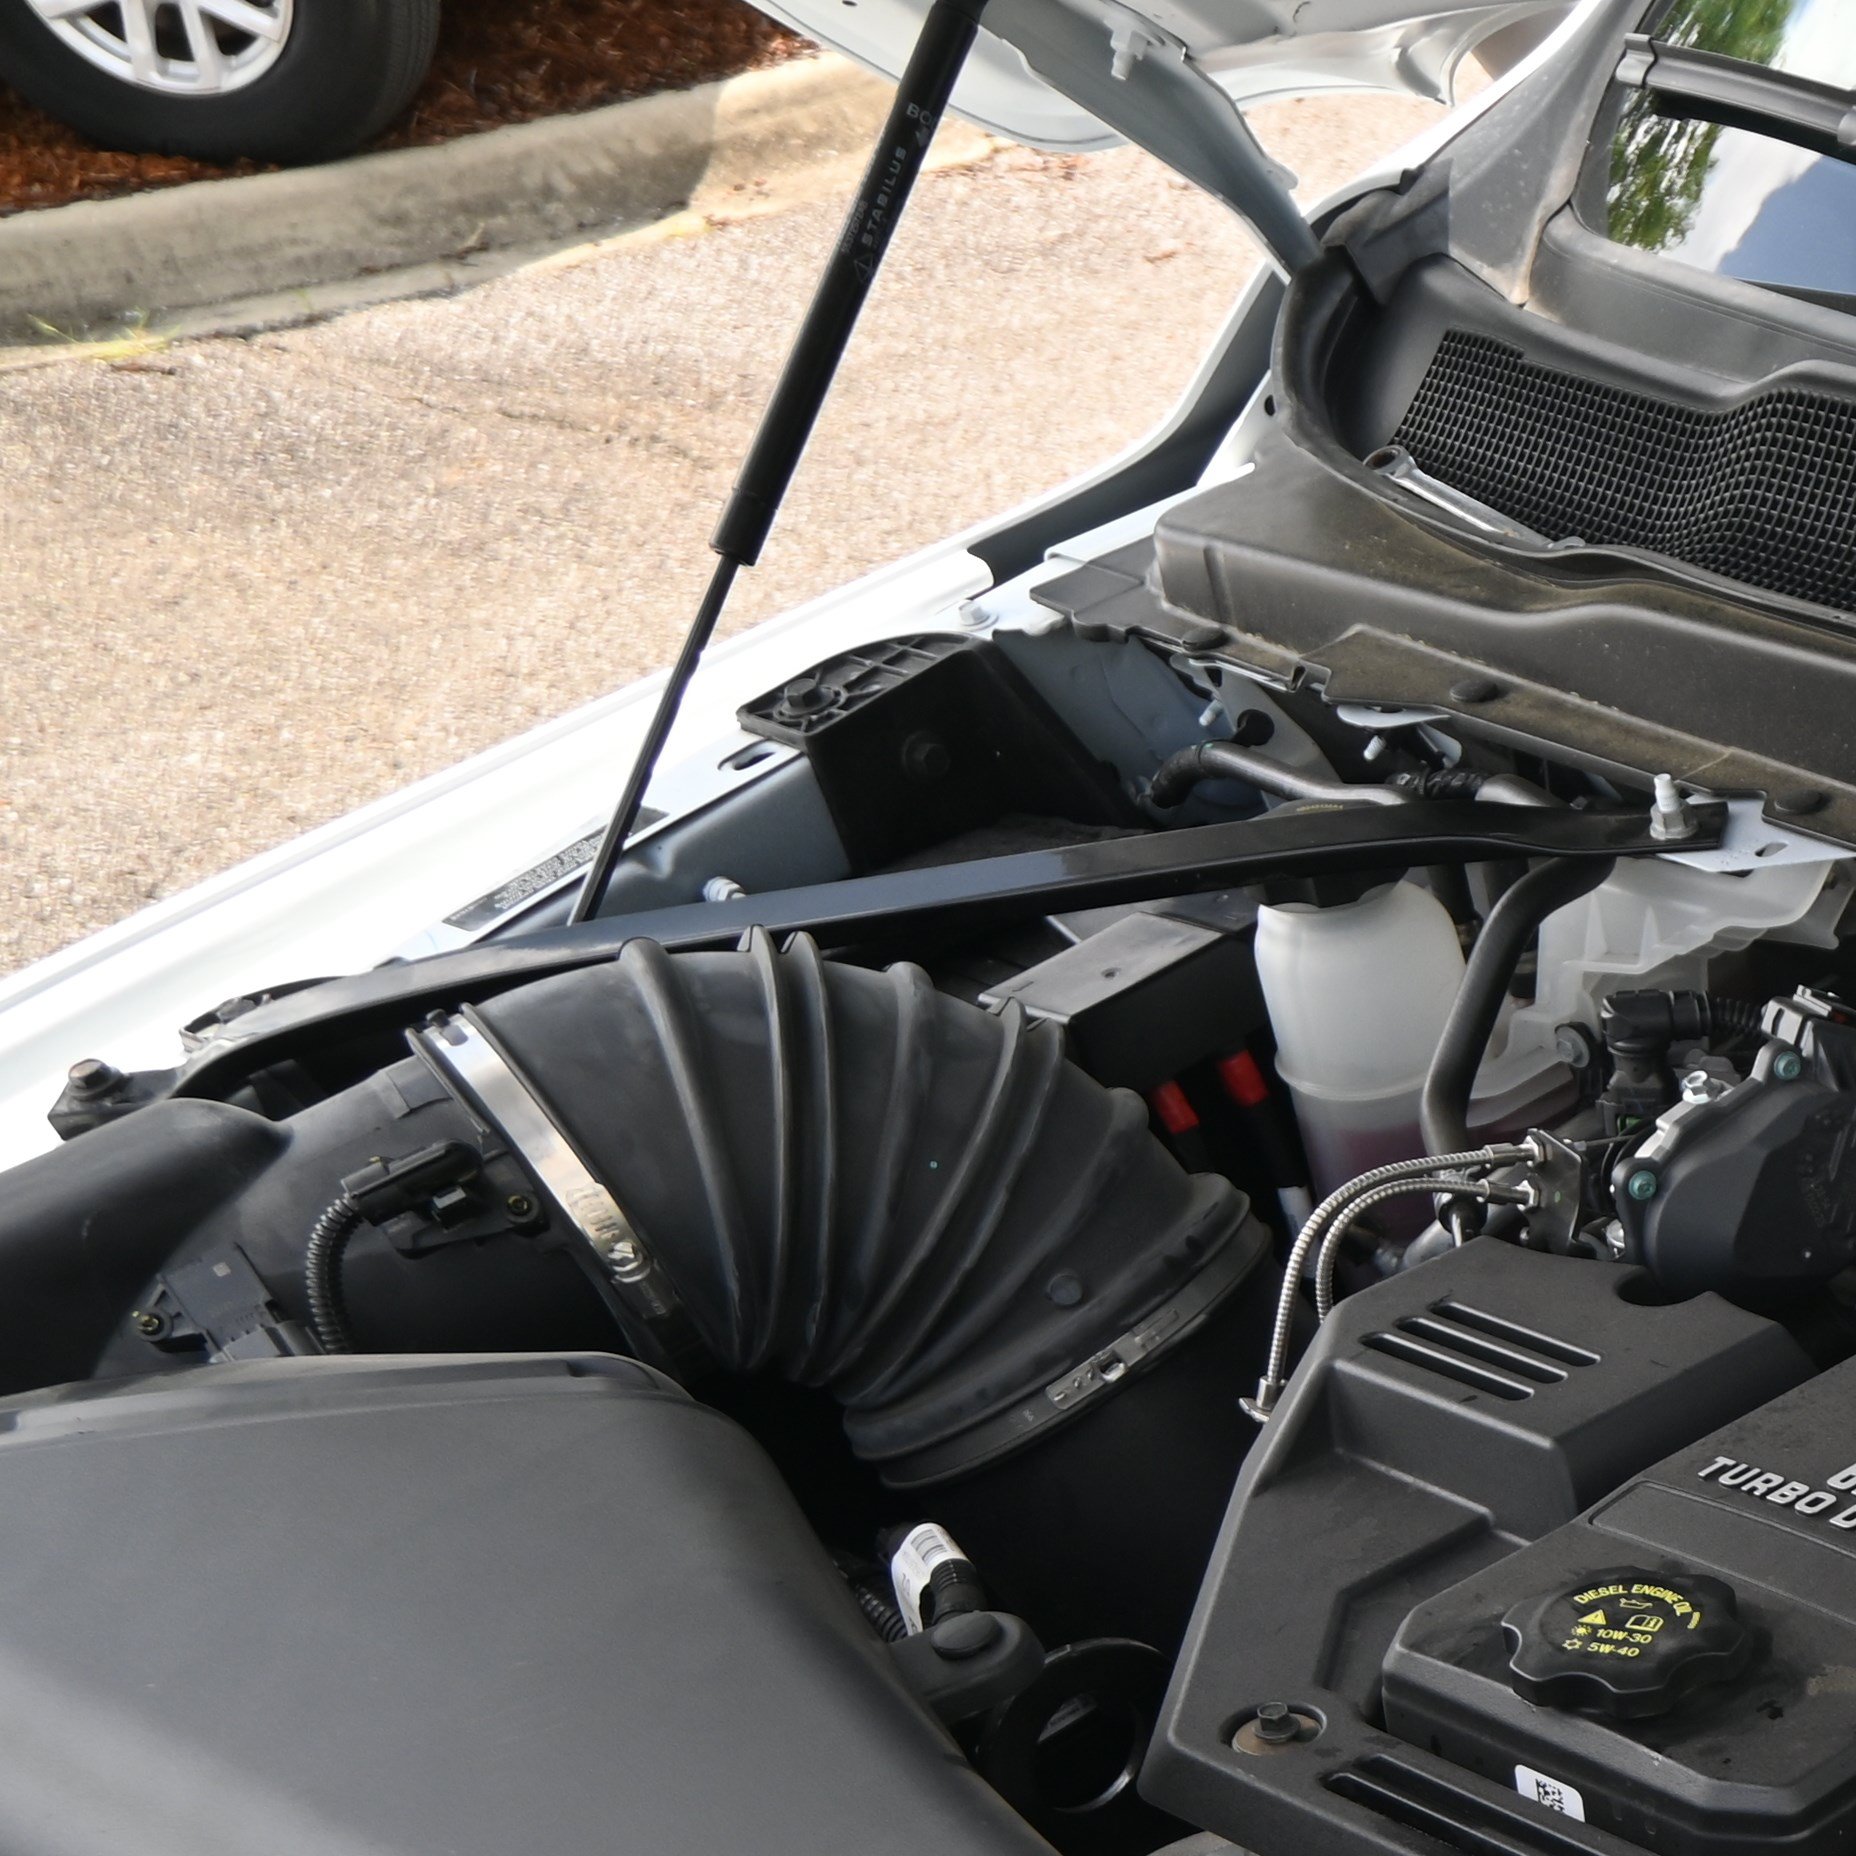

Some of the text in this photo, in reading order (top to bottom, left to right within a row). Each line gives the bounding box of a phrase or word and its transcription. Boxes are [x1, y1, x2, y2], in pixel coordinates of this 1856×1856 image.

[862, 146, 907, 246] STABILUS
[1697, 1456, 1837, 1515] TURBO
[1573, 1585, 1628, 1604] DIESEL
[1631, 1584, 1684, 1604] ENGINE
[1596, 1628, 1653, 1644] 10W-30
[1587, 1641, 1640, 1657] 5W-40
